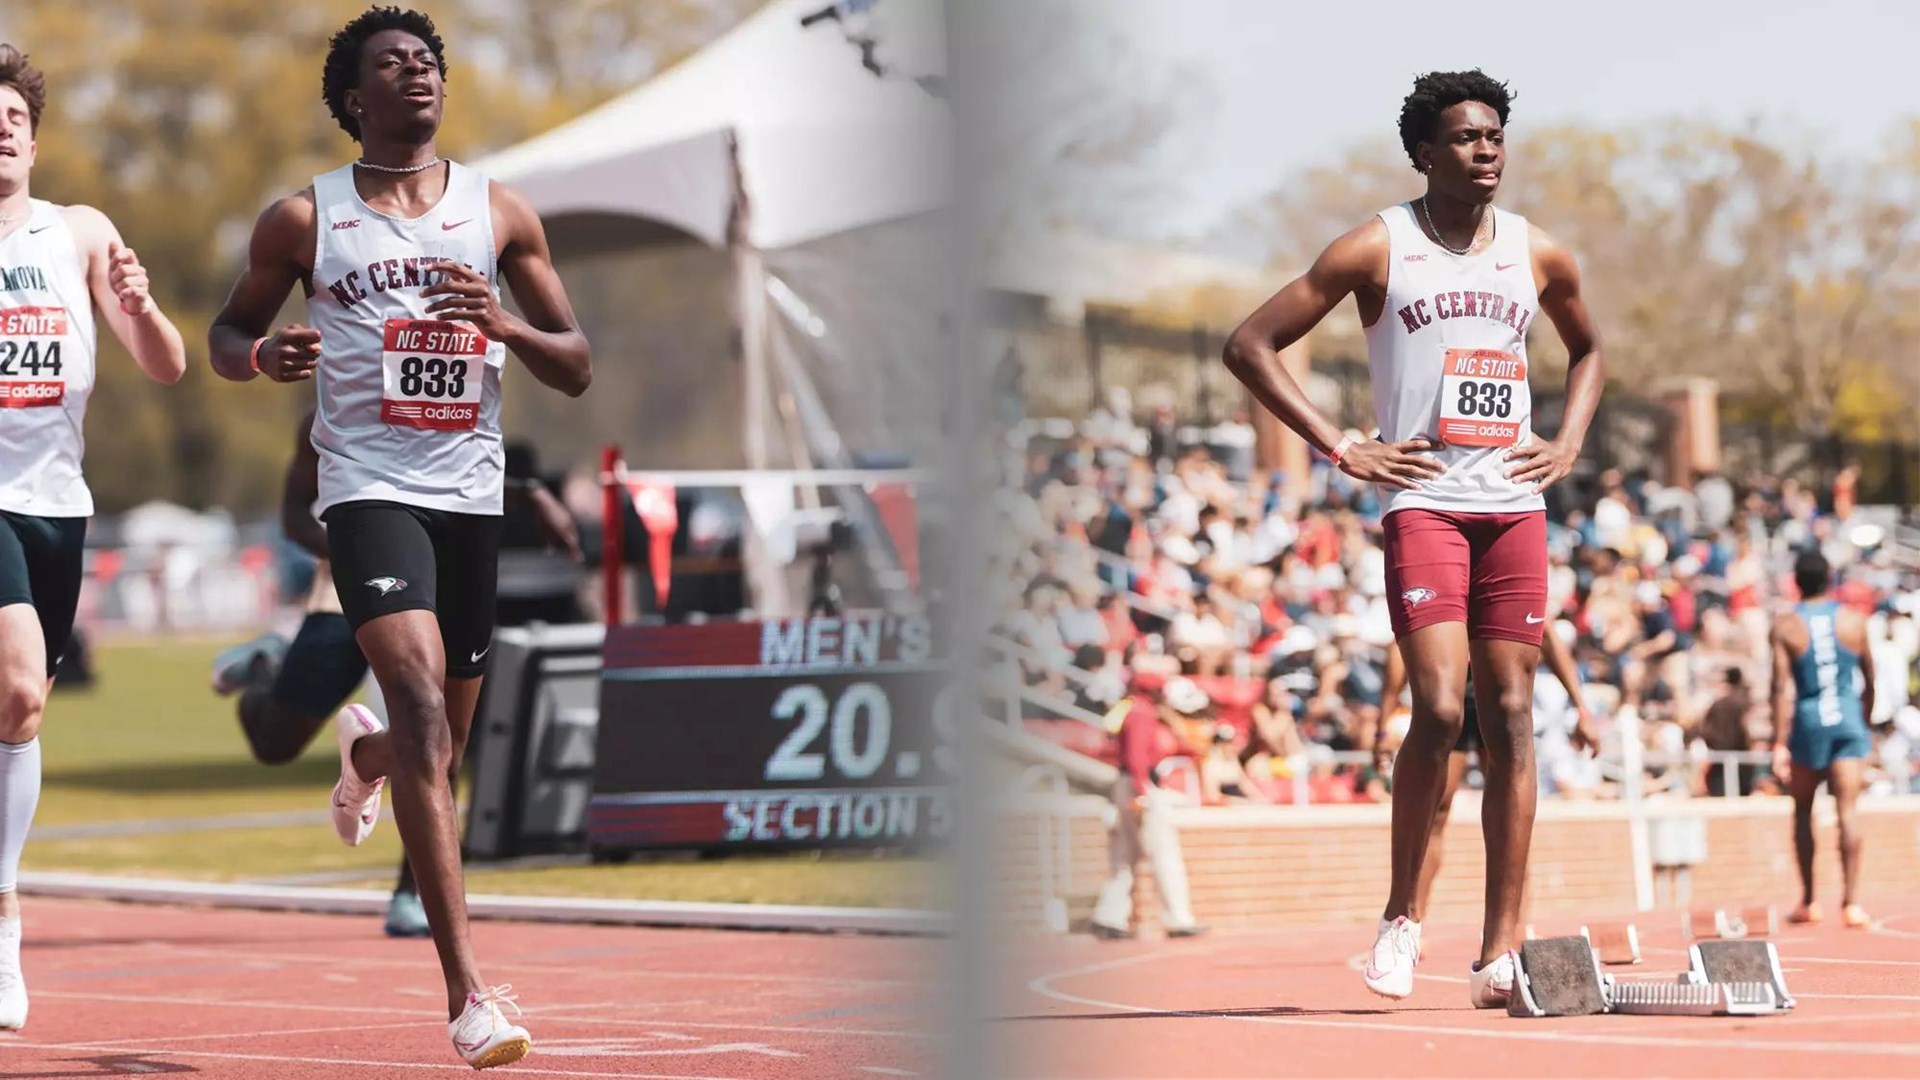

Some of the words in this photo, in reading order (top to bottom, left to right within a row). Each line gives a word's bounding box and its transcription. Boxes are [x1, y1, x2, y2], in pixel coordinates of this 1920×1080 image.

[332, 219, 361, 230] MEAC
[1403, 254, 1428, 262] MEAC
[0, 266, 48, 293] ANOVA
[328, 270, 367, 310] NC
[367, 256, 485, 293] CENT
[6, 314, 57, 335] STATE
[1398, 299, 1432, 334] NC
[1434, 290, 1530, 336] CENTRAL
[396, 330, 423, 349] NC
[425, 331, 478, 353] STATE
[0, 341, 62, 376] 244
[1454, 357, 1478, 374] NC
[1480, 359, 1519, 377] STATE
[400, 357, 467, 398] 833
[12, 384, 60, 399] adidas
[1457, 381, 1512, 418] 833
[424, 407, 473, 421] adidas
[1478, 423, 1515, 438] adidas
[760, 614, 932, 665] MEN'S
[723, 797, 920, 842] SECTION
